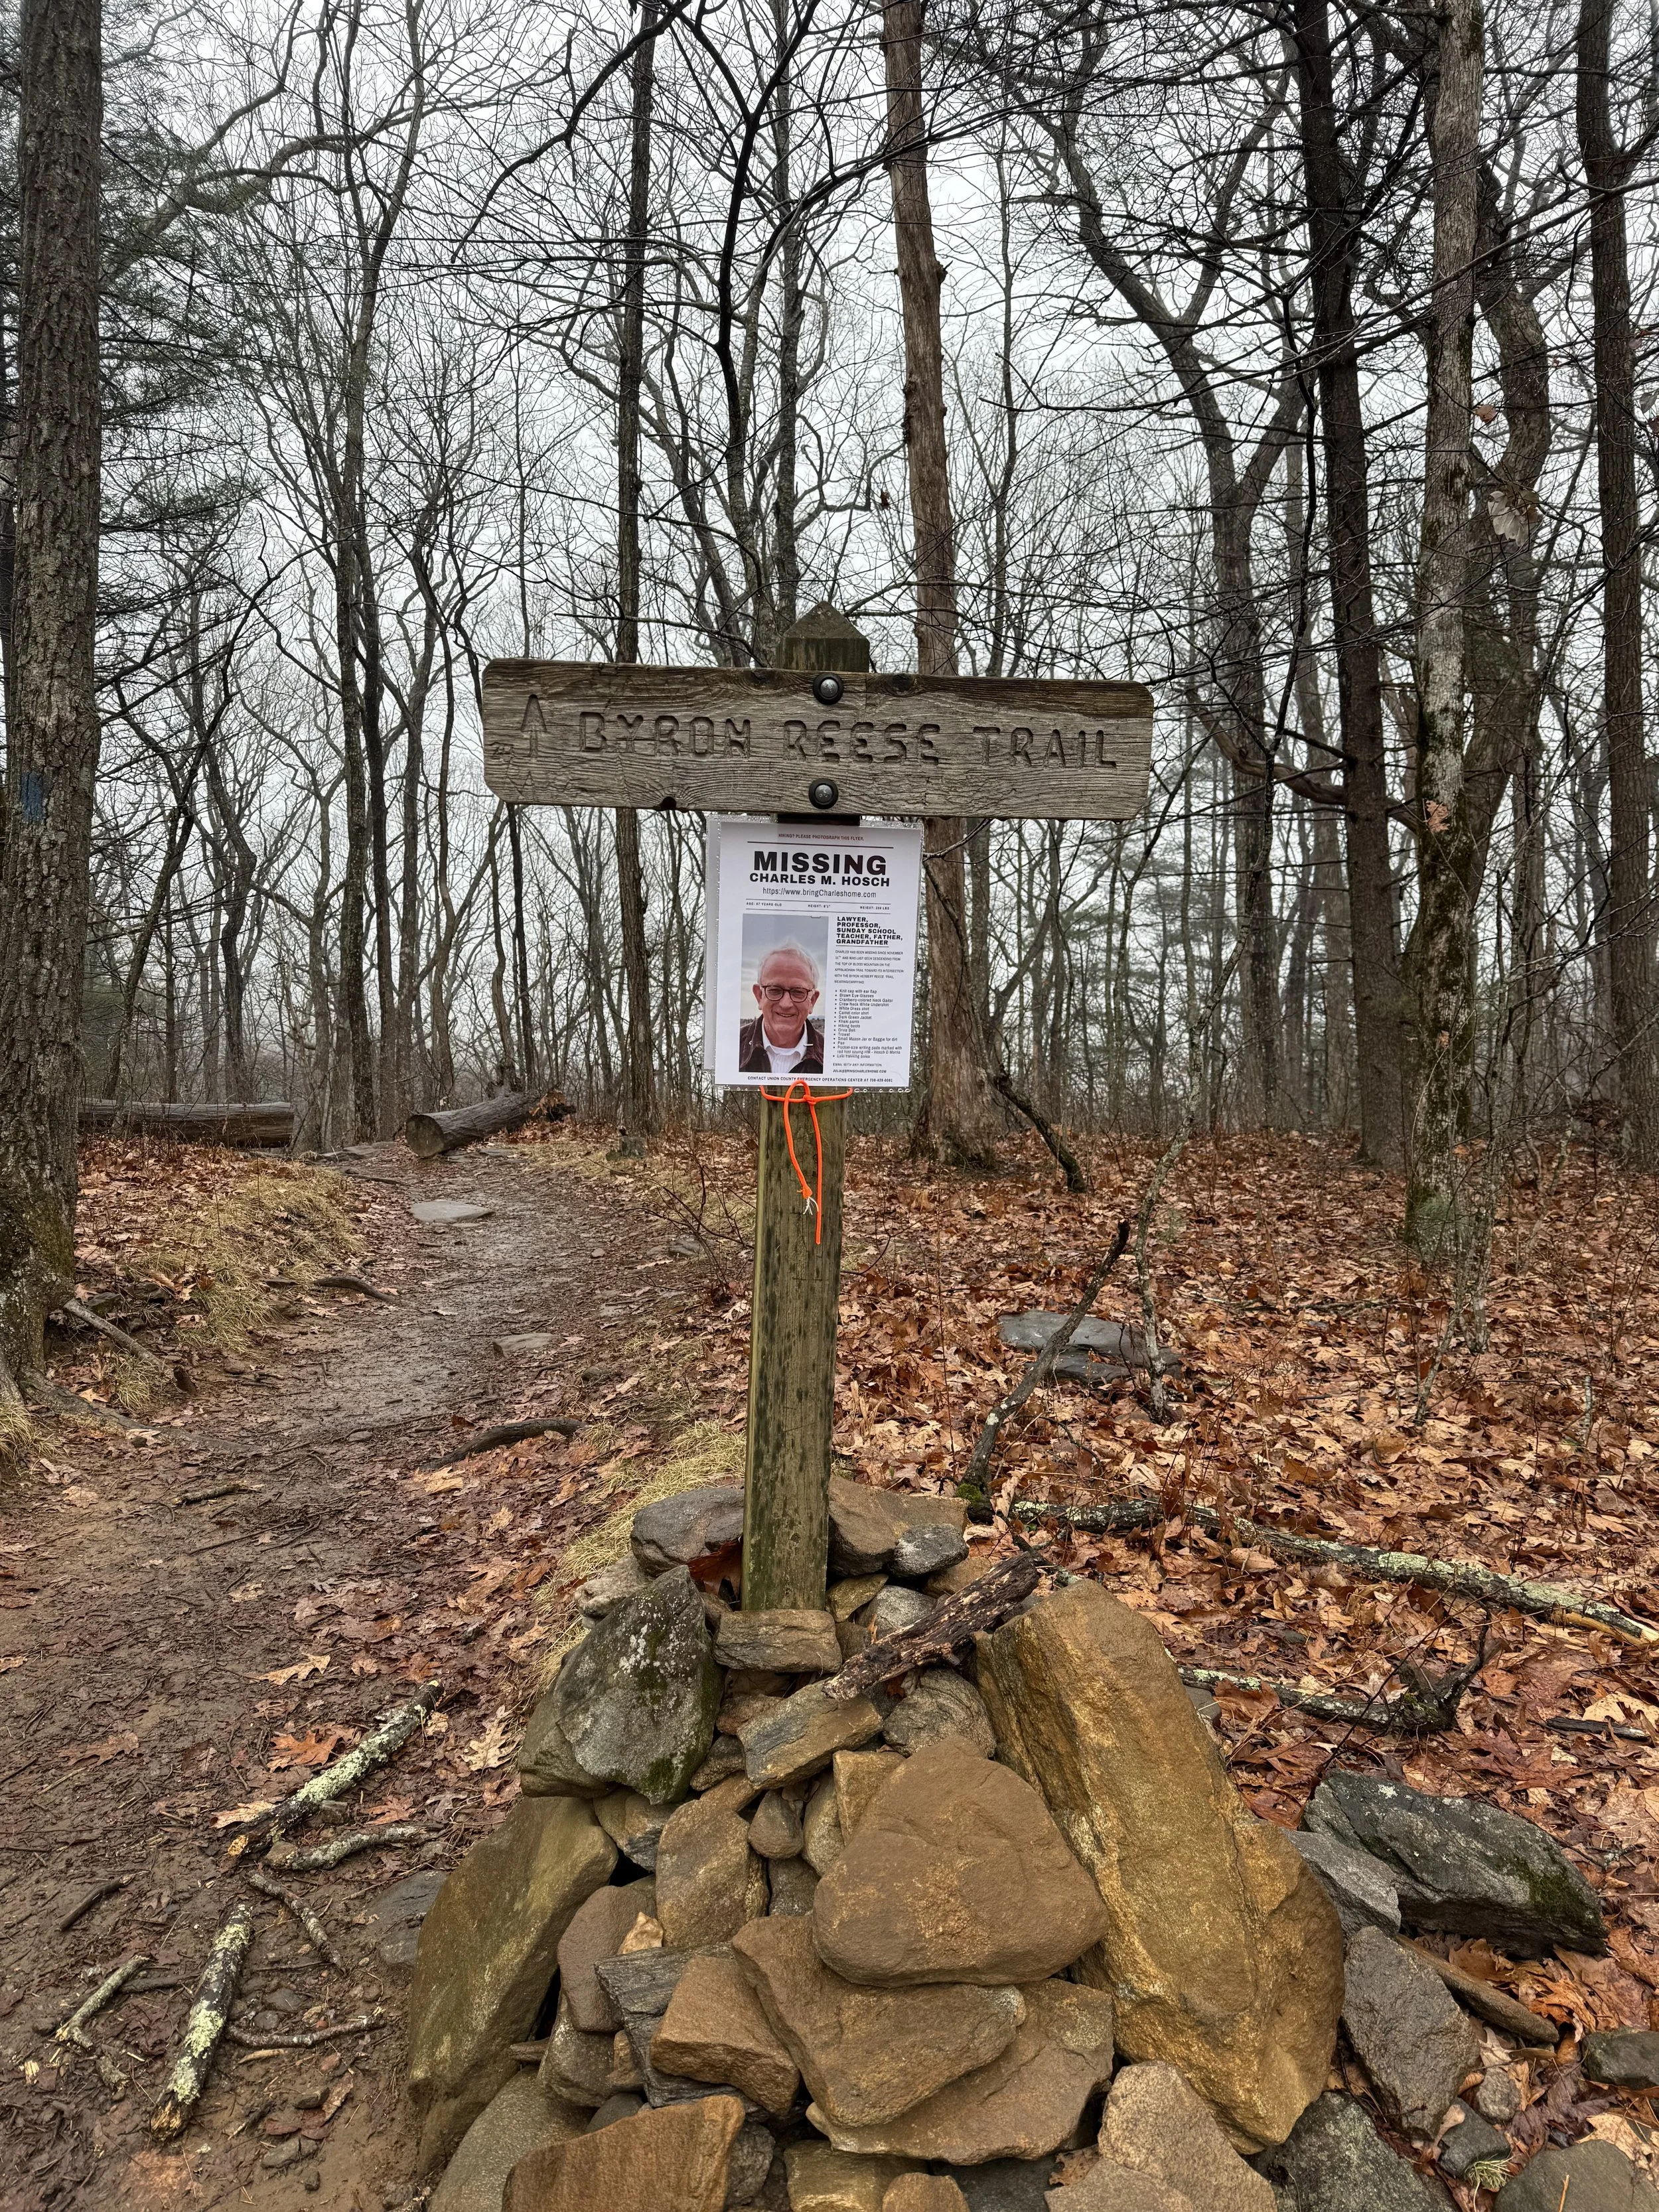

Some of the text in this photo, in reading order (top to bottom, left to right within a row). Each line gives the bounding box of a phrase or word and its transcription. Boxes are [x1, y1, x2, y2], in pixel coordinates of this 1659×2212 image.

[579, 711, 1117, 768] BYRON REESE TRAIL
[754, 851, 886, 875] MISSING
[750, 873, 889, 887] CHARLES M. HOSCH
[763, 887, 876, 898] https://www.bringCharleshome.com
